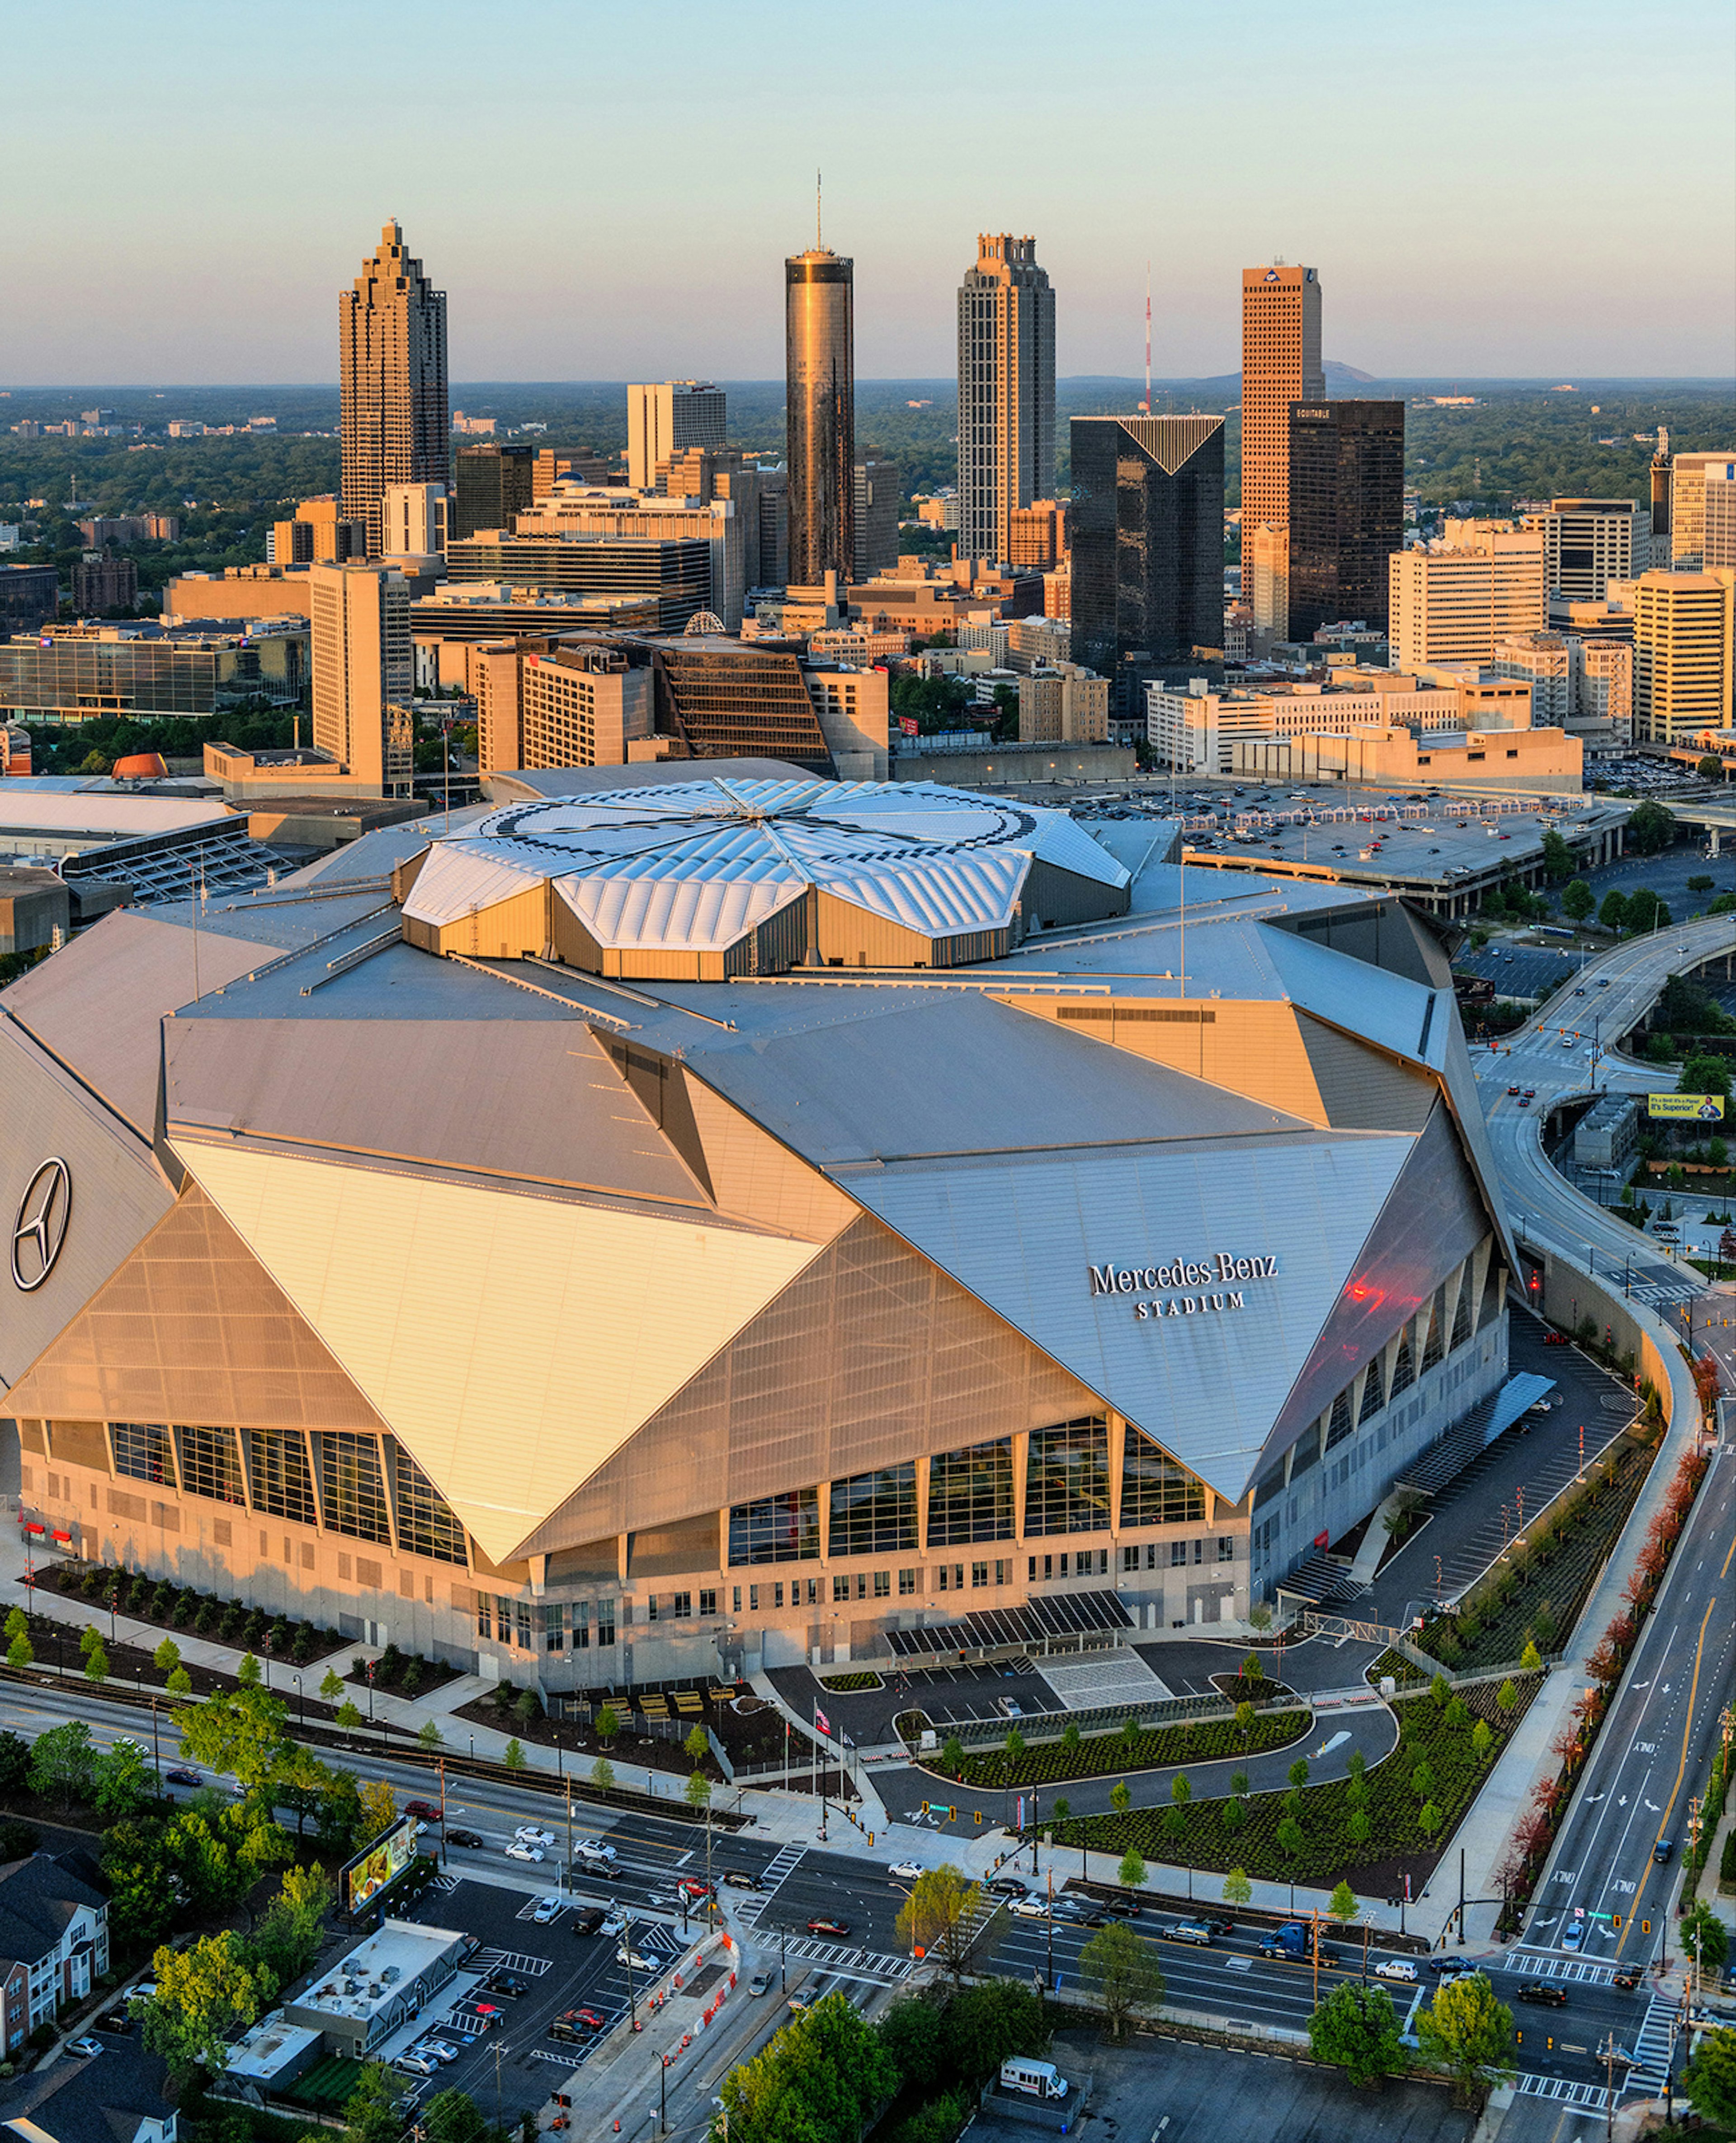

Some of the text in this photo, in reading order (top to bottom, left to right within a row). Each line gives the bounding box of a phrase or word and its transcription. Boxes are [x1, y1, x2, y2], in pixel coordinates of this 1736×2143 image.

[1090, 1252, 1278, 1296] Mercedes-Benz
[1136, 1291, 1245, 1319] STADIUM
[1632, 1741, 1655, 1754] ONLY
[1551, 1870, 1576, 1884] ONLY
[1611, 1879, 1636, 1894] ONLY
